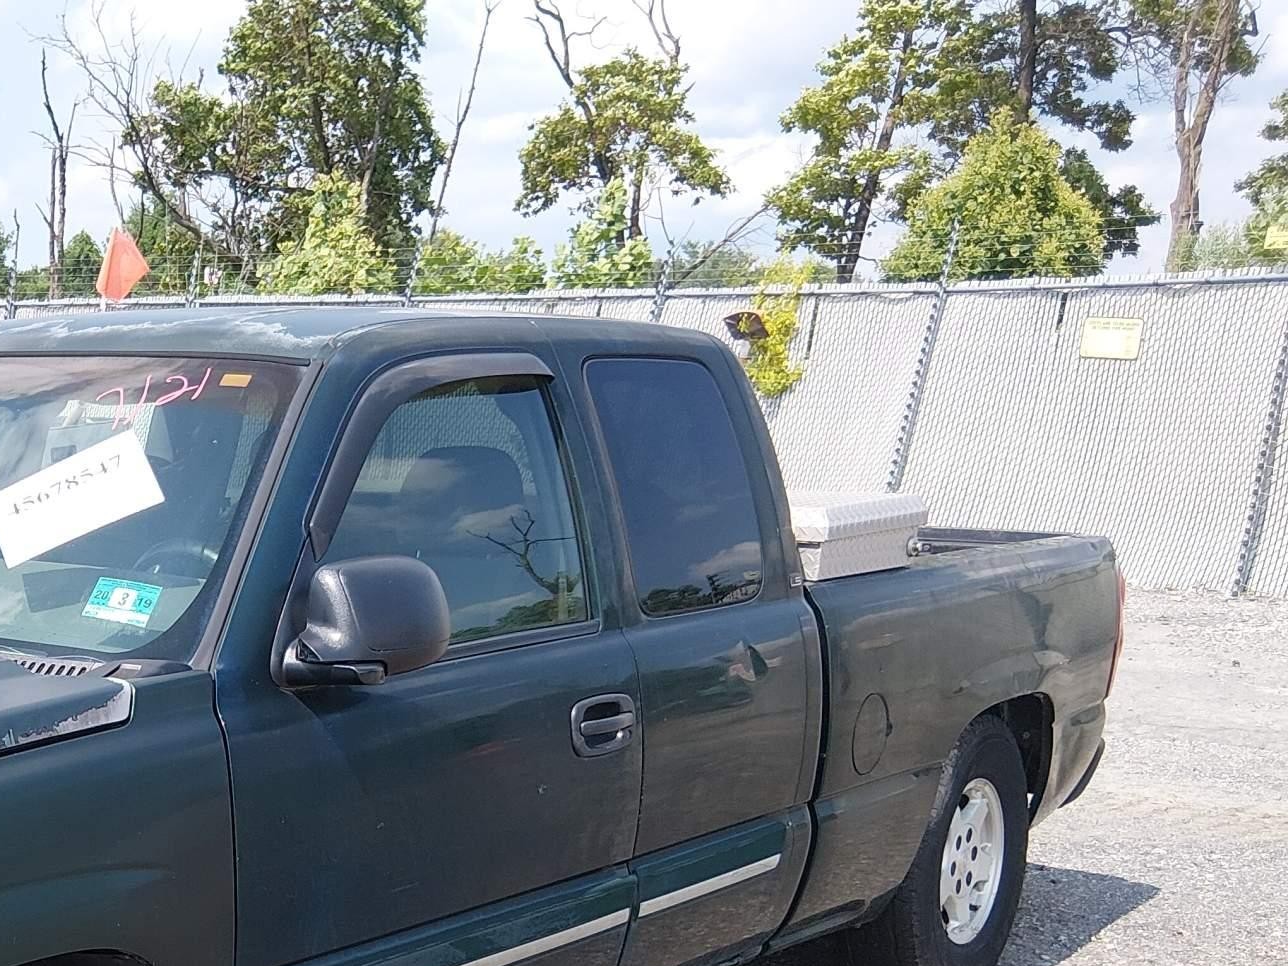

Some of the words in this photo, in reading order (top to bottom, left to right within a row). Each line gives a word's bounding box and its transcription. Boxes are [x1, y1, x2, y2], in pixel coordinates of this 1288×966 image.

[93, 590, 110, 601] 20
[117, 592, 130, 606] 3
[137, 597, 153, 609] 19
